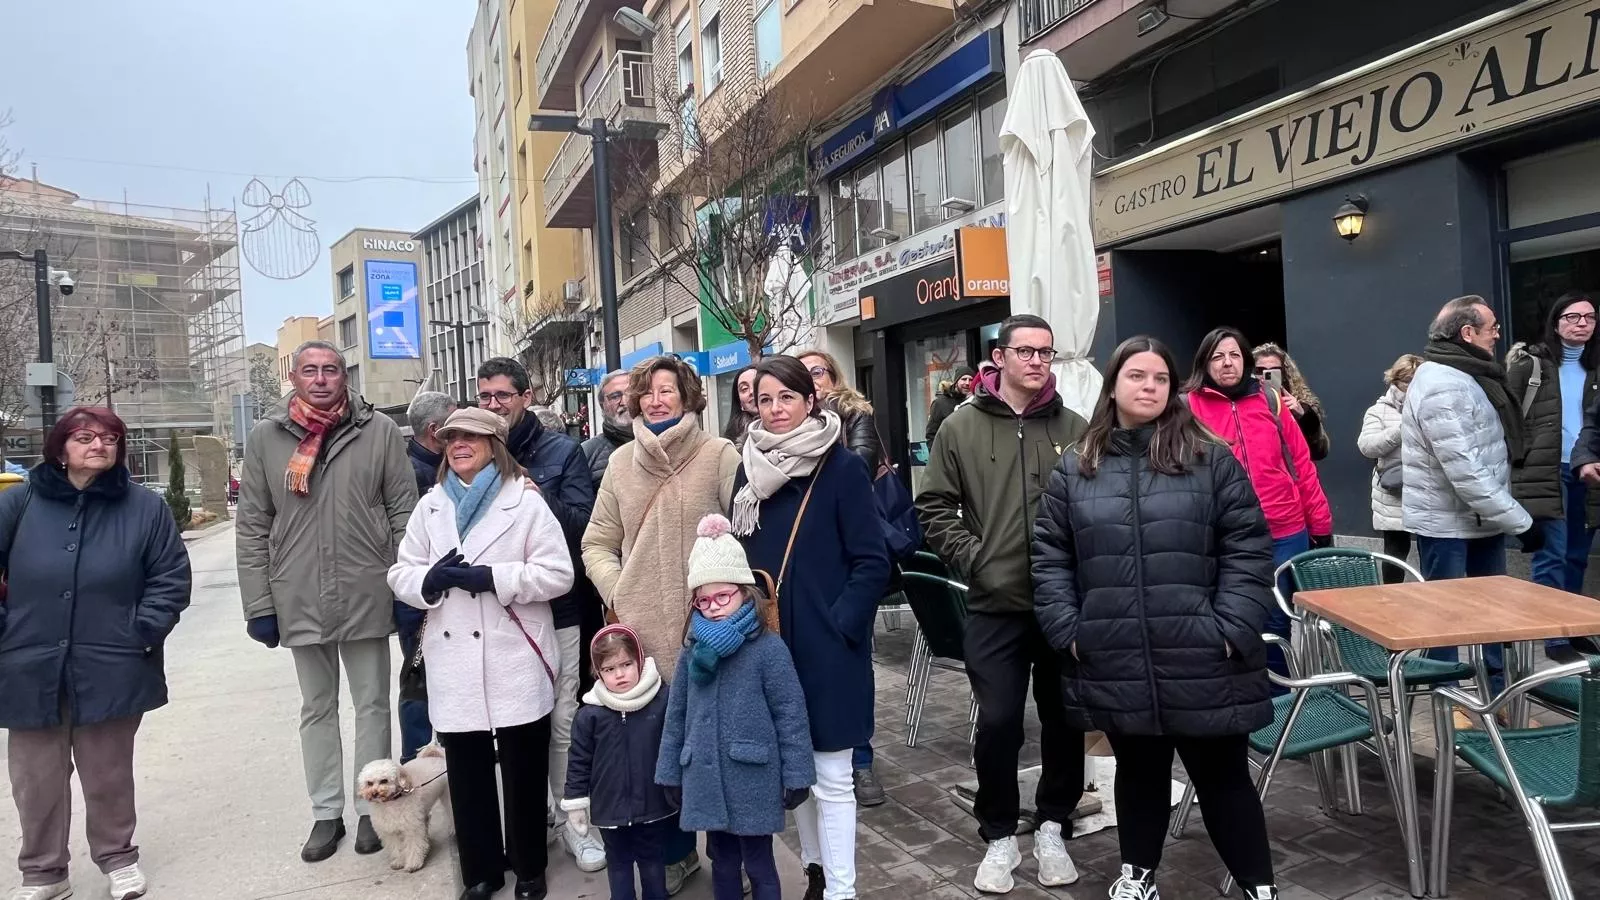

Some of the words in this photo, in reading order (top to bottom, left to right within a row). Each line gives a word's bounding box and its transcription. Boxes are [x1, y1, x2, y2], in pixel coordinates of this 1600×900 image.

[872, 110, 890, 139] AXA
[830, 131, 867, 165] SEGUROS
[1114, 174, 1187, 216] GASTRO
[1192, 136, 1255, 200] EL
[1265, 70, 1443, 166] VIEJO
[363, 237, 415, 252] HINACO
[916, 275, 960, 305] Orang
[967, 278, 1009, 293] orang
